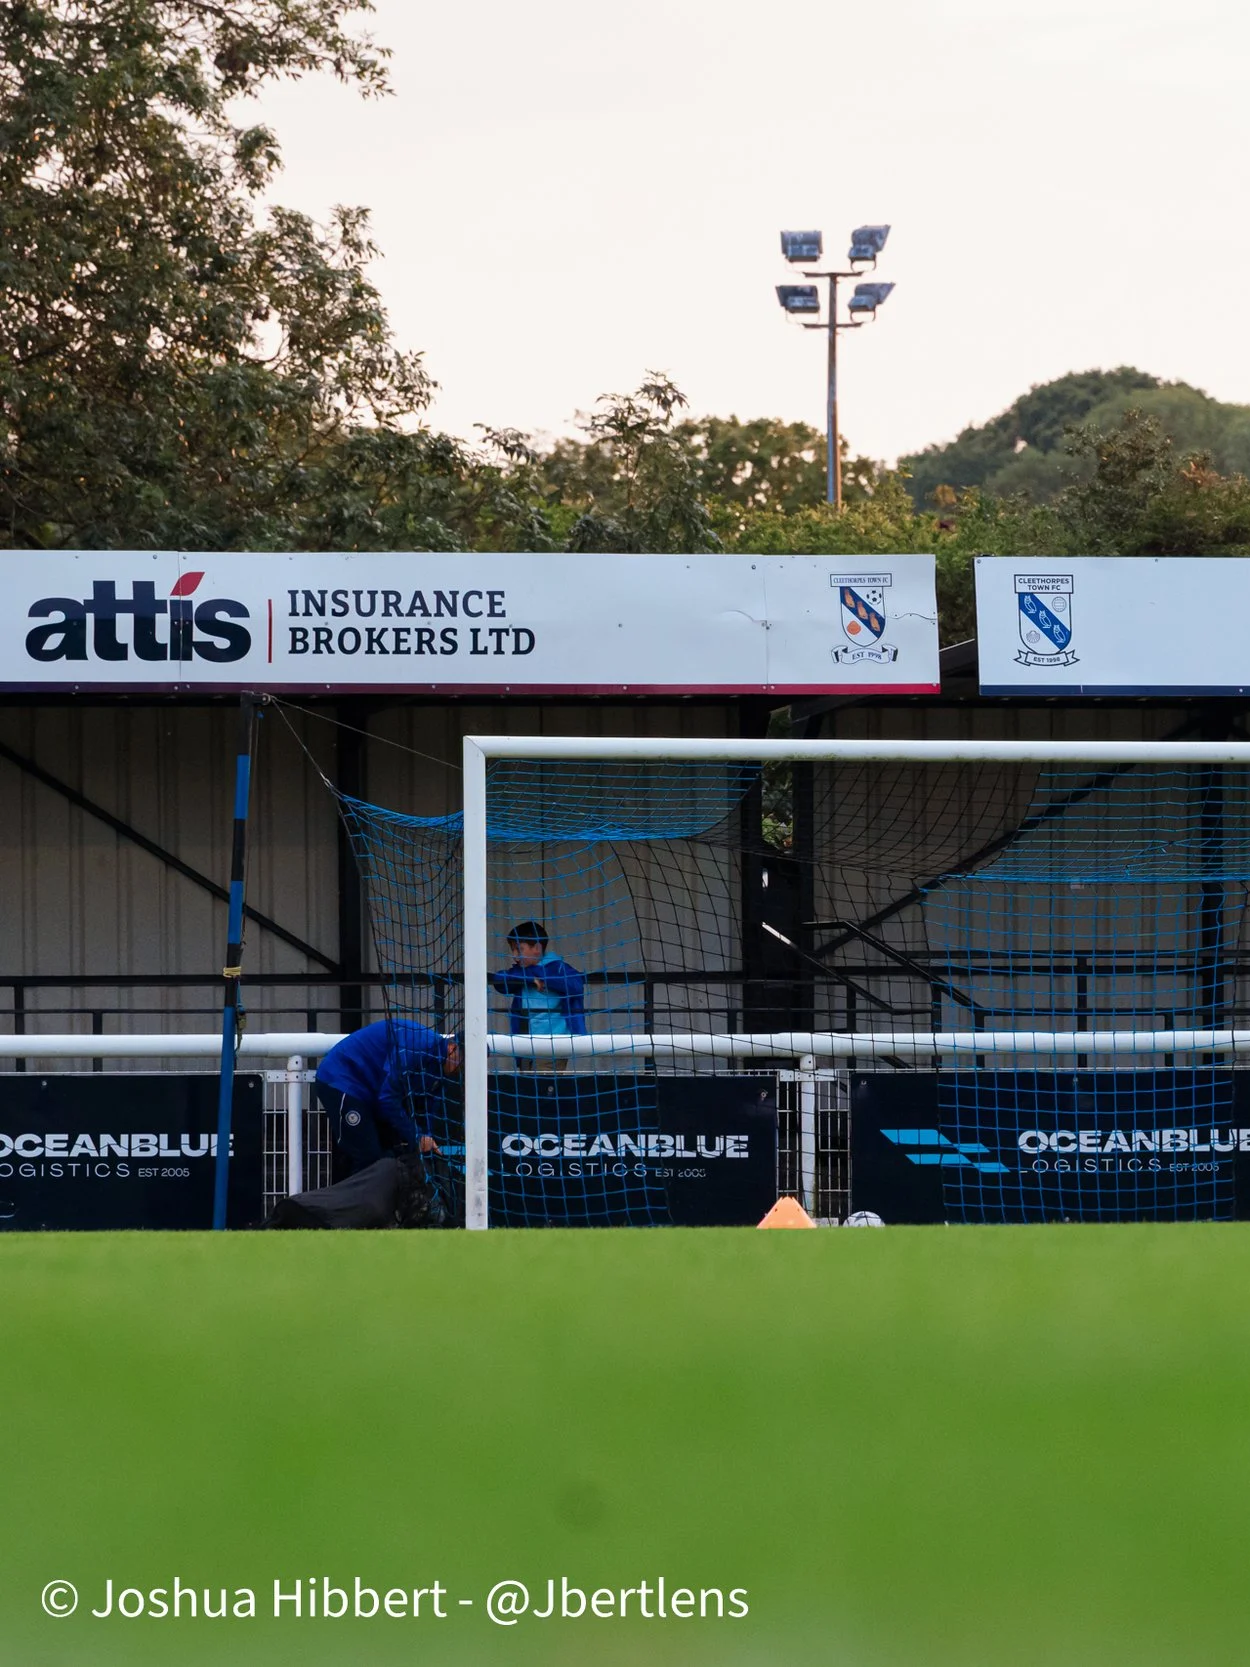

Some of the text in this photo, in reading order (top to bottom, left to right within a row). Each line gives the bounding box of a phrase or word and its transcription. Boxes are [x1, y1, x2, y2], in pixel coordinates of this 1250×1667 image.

[287, 589, 507, 618] INSURANCE
[26, 572, 251, 663] attis
[288, 627, 536, 656] BROKERS LTD
[852, 651, 864, 660] EST
[501, 1133, 749, 1158] OCEANBLUE
[138, 1168, 158, 1177] EST
[161, 1168, 190, 1177] 2005
[1169, 1163, 1189, 1172] EST
